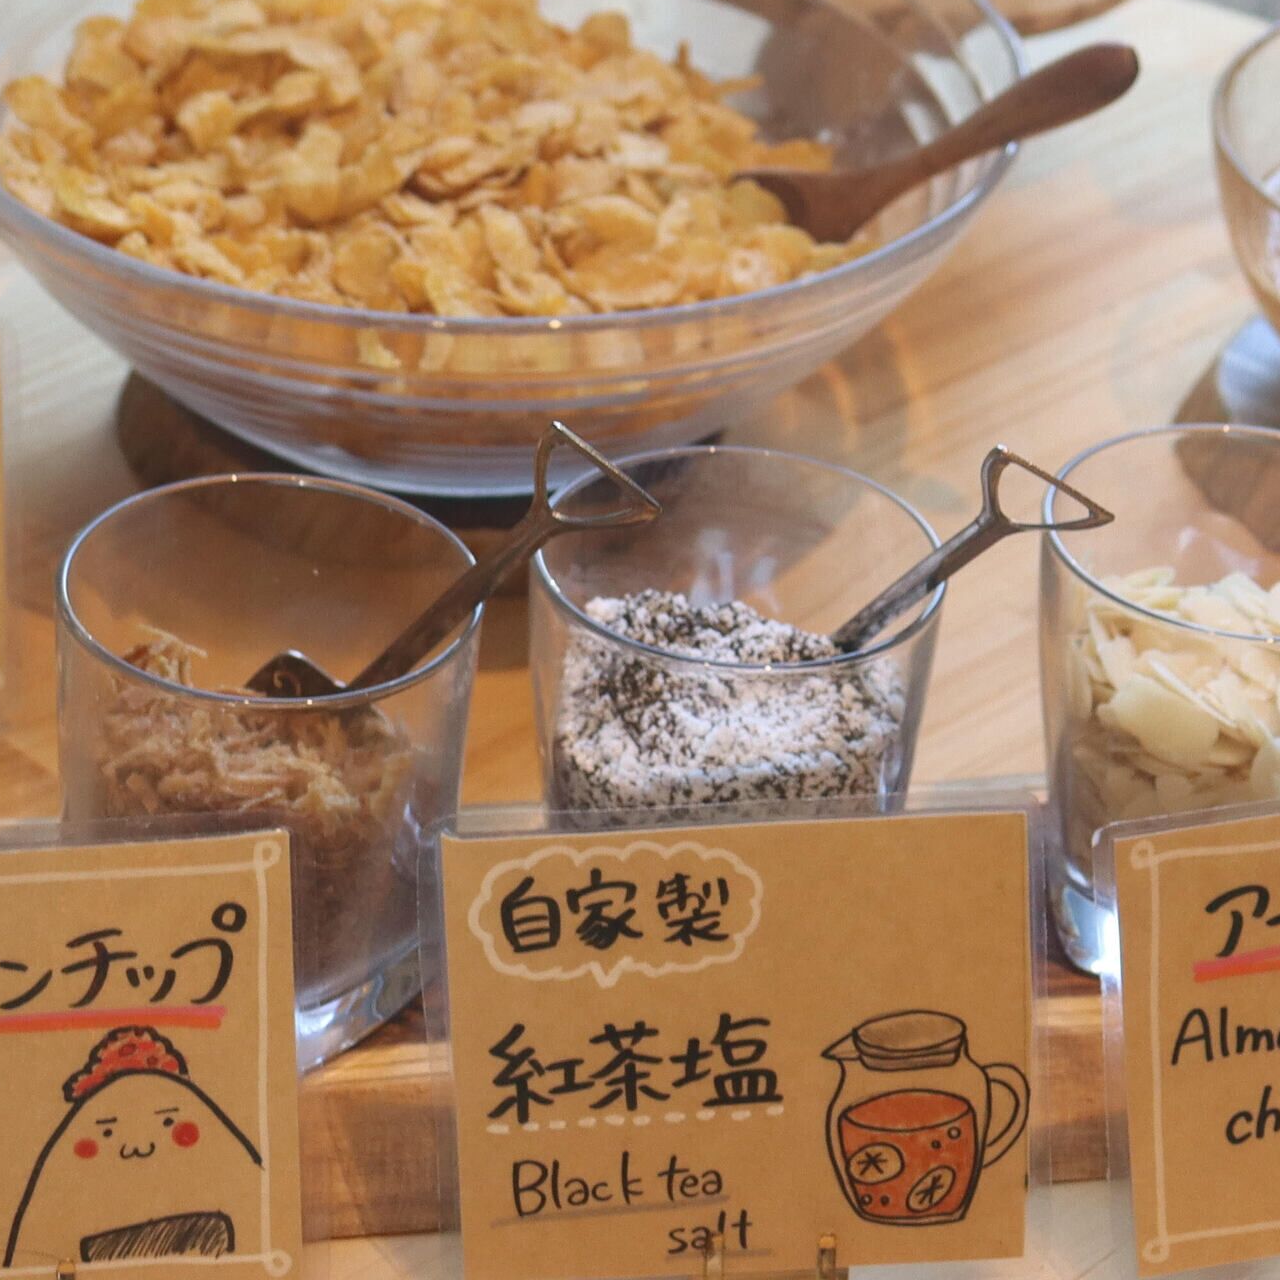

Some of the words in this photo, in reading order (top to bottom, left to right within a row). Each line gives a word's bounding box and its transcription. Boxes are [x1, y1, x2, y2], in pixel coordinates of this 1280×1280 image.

[500, 868, 730, 953] 自家製
[486, 1013, 783, 1124] 紅茶塩
[511, 1150, 643, 1217] Black
[657, 1155, 724, 1203] tea
